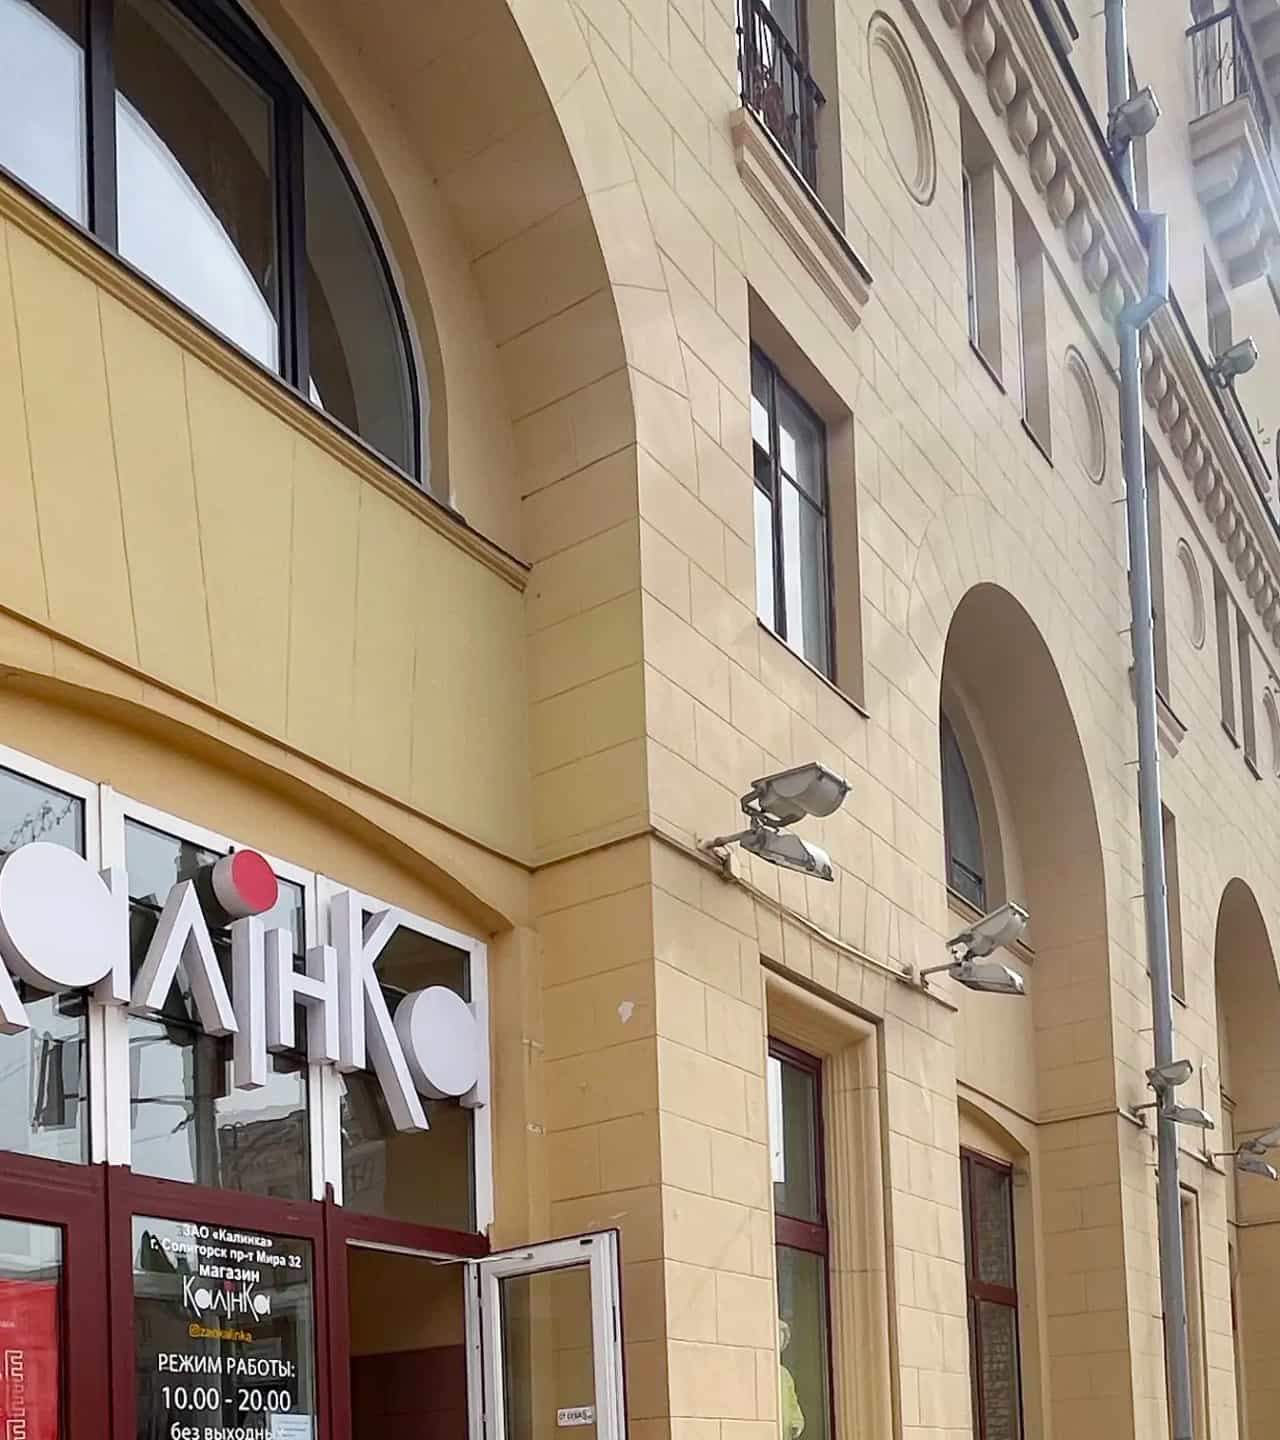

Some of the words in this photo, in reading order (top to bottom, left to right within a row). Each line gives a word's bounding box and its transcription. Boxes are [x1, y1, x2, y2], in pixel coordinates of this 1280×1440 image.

[183, 1223, 209, 1239] ЗАО
[256, 1251, 286, 1269] Мира
[288, 1255, 303, 1269] 32
[199, 1263, 260, 1283] магазин
[158, 1353, 222, 1374] РЕЖИМ
[226, 1357, 296, 1378] РАБОТЫ:
[162, 1386, 220, 1411] 10.00
[238, 1389, 291, 1412] 20.00
[171, 1421, 201, 1440] без
